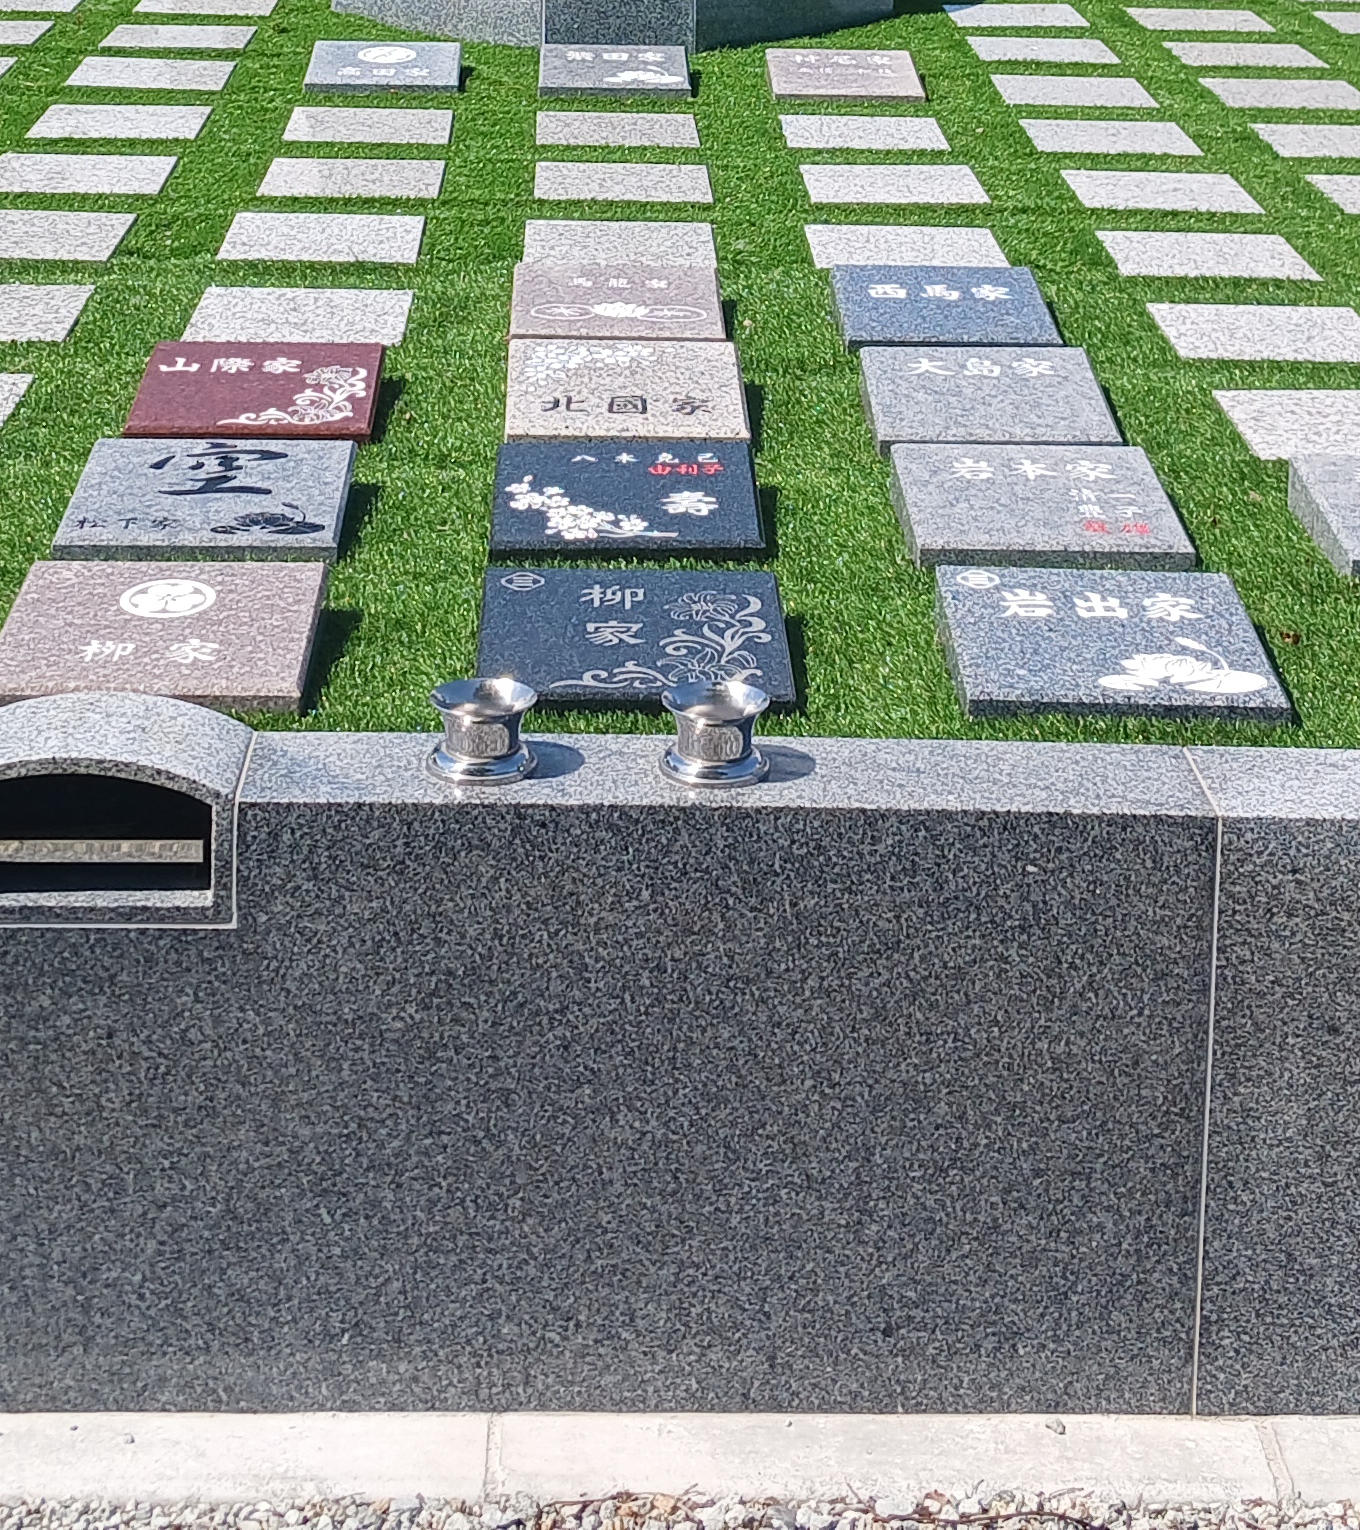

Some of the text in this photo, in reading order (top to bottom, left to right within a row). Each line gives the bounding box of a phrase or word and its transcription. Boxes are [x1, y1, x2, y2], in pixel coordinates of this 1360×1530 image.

[540, 395, 714, 416] 北國家
[999, 588, 1206, 622] 岩出家
